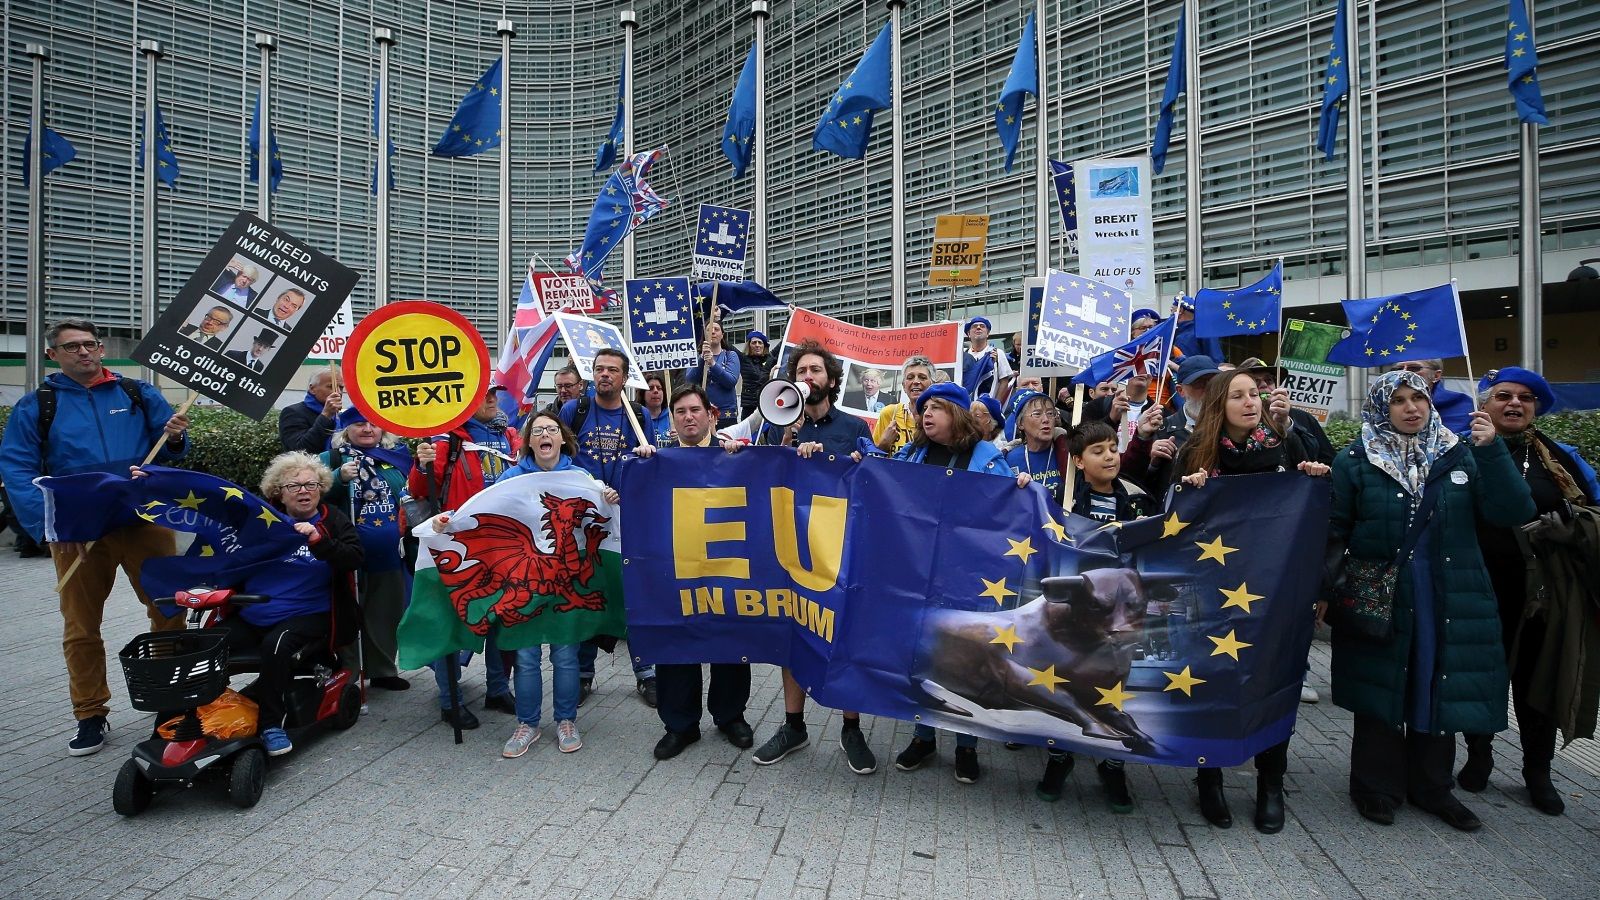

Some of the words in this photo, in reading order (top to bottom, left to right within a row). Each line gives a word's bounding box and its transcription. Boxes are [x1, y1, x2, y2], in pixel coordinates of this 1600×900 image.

[1094, 214, 1138, 225] BREXIT
[1094, 230, 1129, 238] Wrecks
[1130, 228, 1139, 237] it
[246, 222, 271, 242] WE
[271, 236, 312, 265] NEED
[935, 242, 969, 254] STOP
[236, 235, 329, 292] IMMIGRANTS
[694, 257, 744, 271] WARWICK
[934, 253, 981, 266] BREXIT
[701, 270, 743, 283] EUROPE
[1094, 268, 1110, 277] ALL
[1113, 267, 1126, 276] OF
[1128, 267, 1141, 276] US
[543, 277, 577, 289] VOTE
[545, 288, 590, 300] REMAIN
[546, 300, 560, 310] 23
[803, 314, 816, 324] Do
[818, 319, 835, 330] you
[837, 325, 859, 338] want
[861, 331, 886, 341] these
[888, 333, 906, 341] men
[909, 332, 919, 340] to
[920, 328, 948, 339] decide
[375, 335, 461, 374] STOP
[633, 341, 695, 356] WARWICK
[823, 337, 845, 348] your
[846, 343, 890, 357] children's
[892, 346, 924, 357] future?
[634, 350, 695, 362] DISTRICT
[1038, 346, 1050, 358] 4
[1053, 350, 1092, 370] EUR
[175, 344, 191, 360] to
[193, 355, 236, 382] dilute
[240, 375, 267, 398] this
[646, 357, 698, 371] EUROPE
[1279, 359, 1341, 376] ENVIRONMENT
[149, 351, 189, 376] gene
[189, 371, 228, 396] pool.
[1284, 374, 1338, 395] REXIT
[377, 383, 465, 410] BREXIT
[1286, 390, 1319, 404] ECKS
[1321, 395, 1333, 406] IT
[379, 503, 395, 513] UP
[672, 486, 848, 592] EU
[679, 586, 726, 617] IN
[734, 588, 835, 644] BRUM
